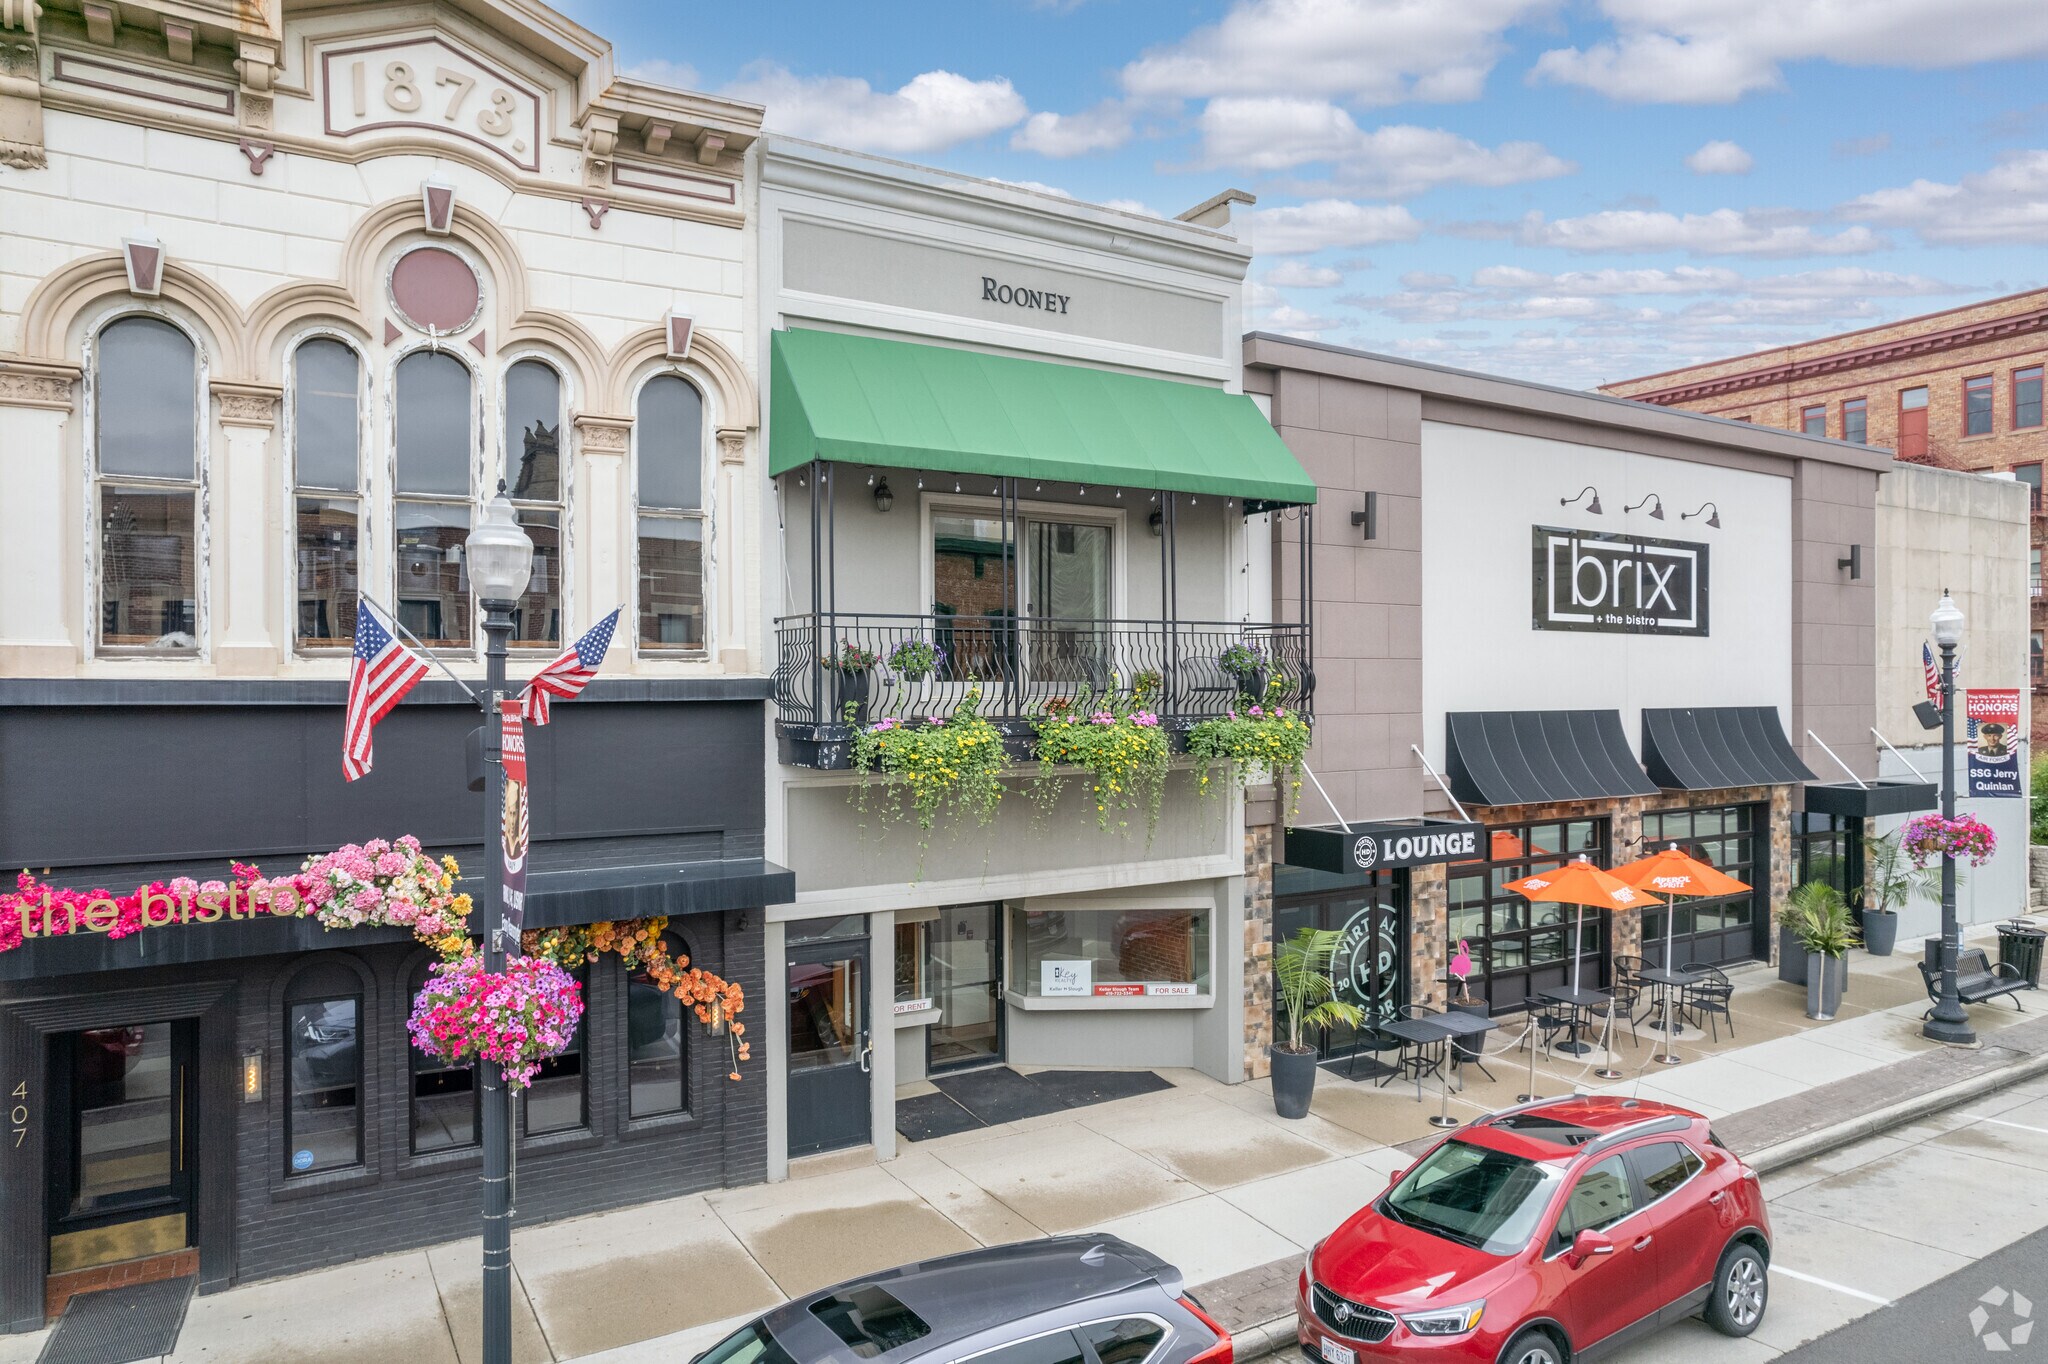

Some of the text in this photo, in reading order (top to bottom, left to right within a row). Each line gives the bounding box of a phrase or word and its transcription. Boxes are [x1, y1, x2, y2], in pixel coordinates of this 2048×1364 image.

[1572, 538, 1677, 611] brix
[1606, 614, 1623, 624] the
[1626, 614, 1656, 626] bistro
[1968, 703, 2018, 712] HONORS
[502, 734, 525, 753] HONORS
[1970, 768, 2018, 780] SSG Jerry
[1975, 782, 2015, 791] Quinlan
[1361, 848, 1371, 856] HD
[1383, 831, 1476, 861] LOUNGE
[1652, 875, 1692, 885] APEROL
[1658, 881, 1685, 889] SPRITZ
[14, 880, 300, 938] the bistro
[1340, 915, 1397, 955] VIRTAL
[894, 1002, 926, 1013] OR RENT
